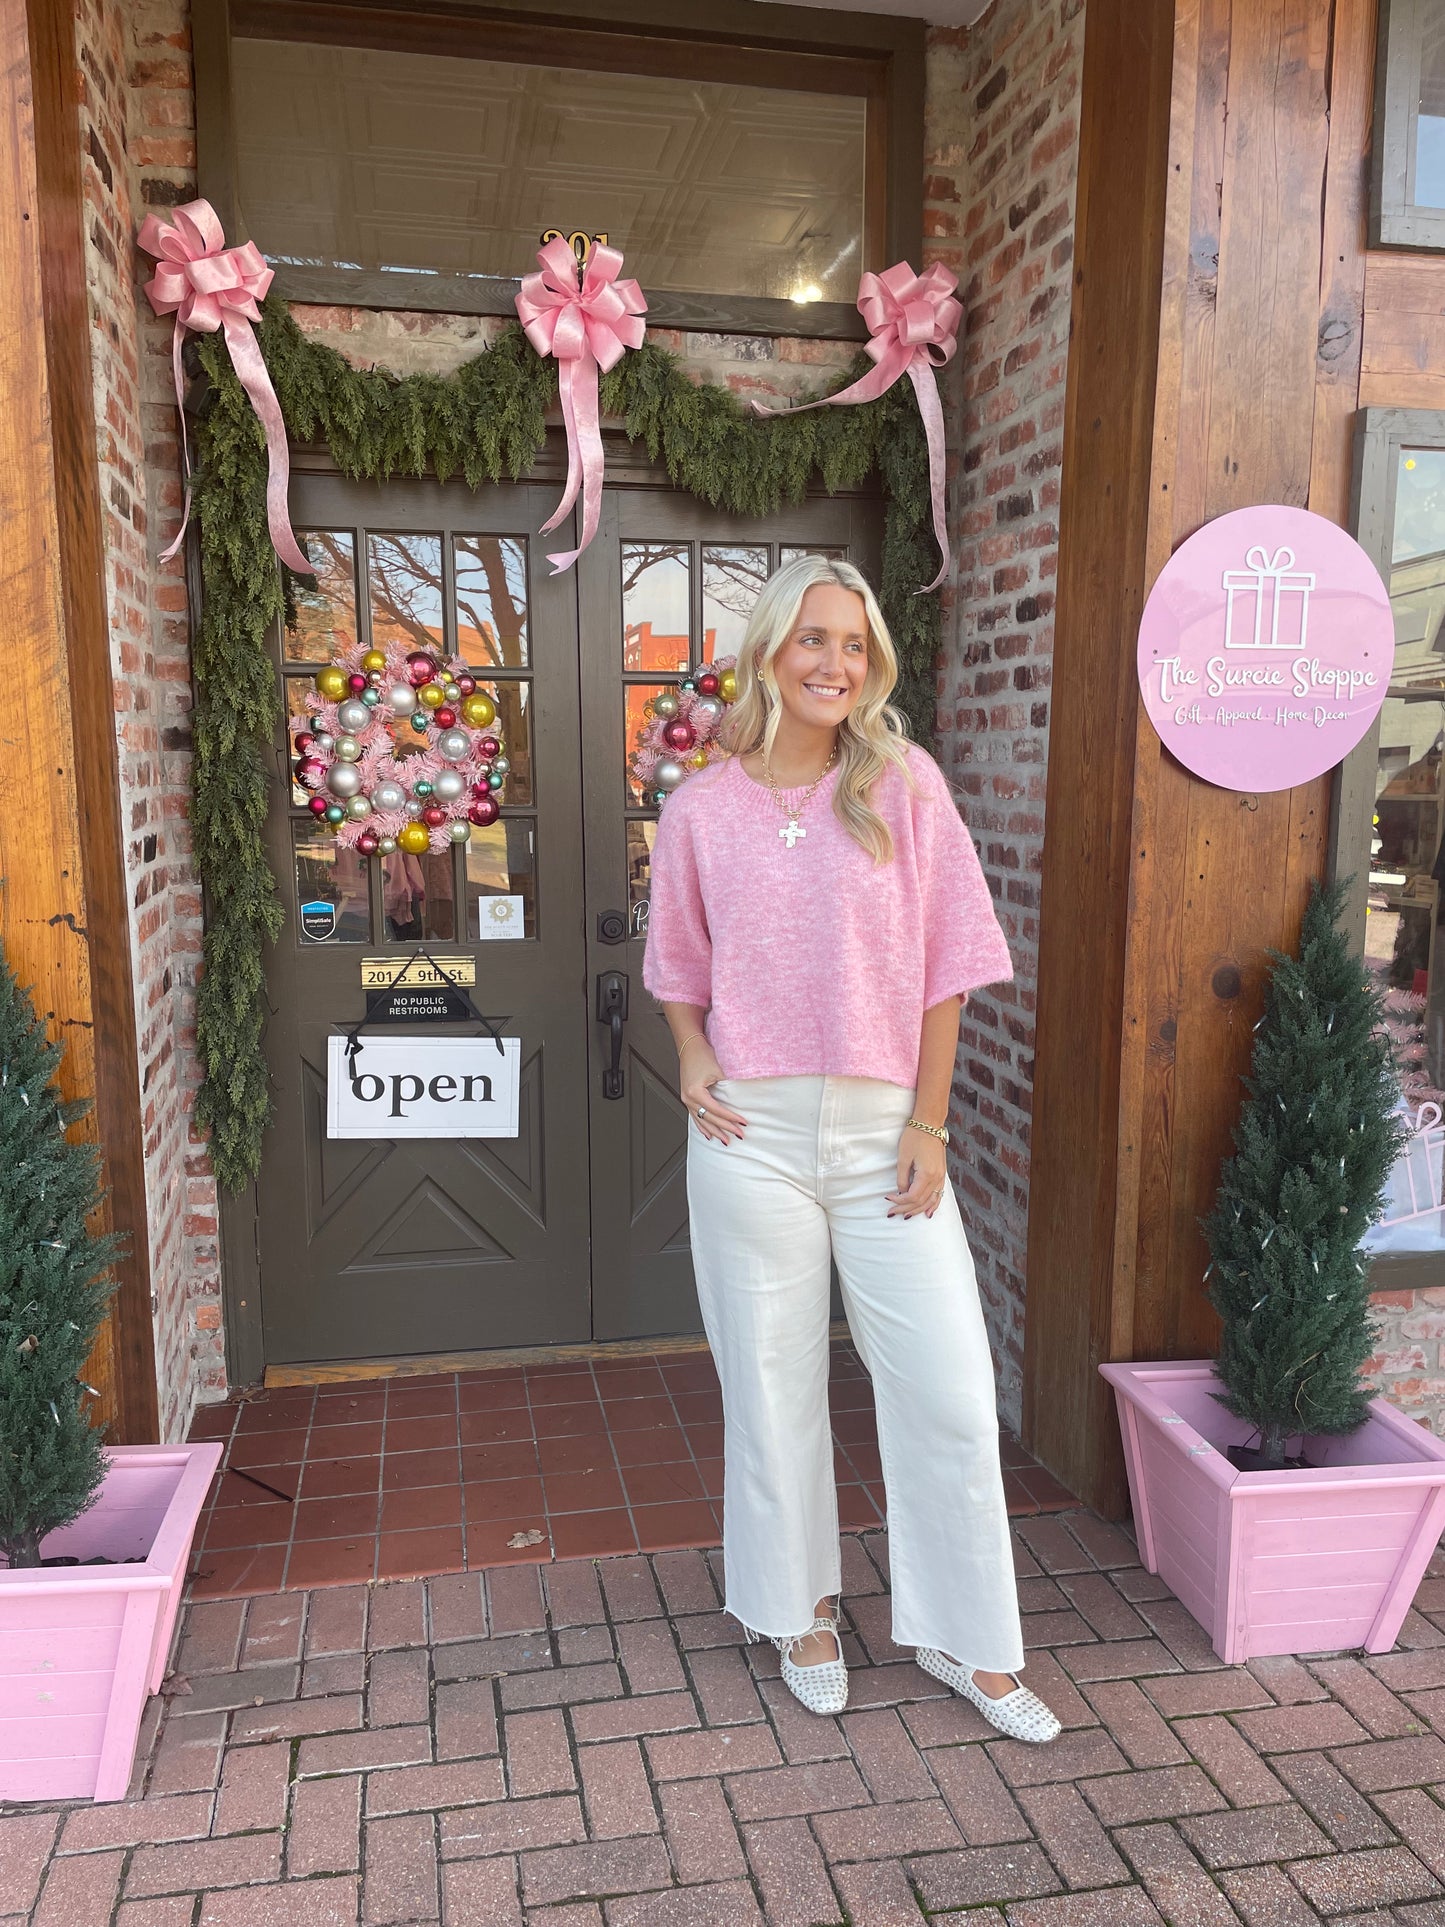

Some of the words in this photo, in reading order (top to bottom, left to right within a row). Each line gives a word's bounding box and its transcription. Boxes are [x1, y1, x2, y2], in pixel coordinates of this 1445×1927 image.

[1153, 656, 1200, 703] The
[1206, 656, 1286, 697] Surcie
[1292, 657, 1378, 700] Shoppe
[1174, 704, 1203, 725] Gift
[1215, 706, 1262, 727] Apparel
[1275, 706, 1308, 727] Home
[1313, 706, 1349, 728] Decor
[368, 971, 392, 983] 201
[418, 969, 443, 982] 9th
[449, 969, 468, 981] St.
[389, 1006, 448, 1015] RESTROOMS
[393, 998, 408, 1006] NO
[410, 997, 444, 1005] PUBLIC
[351, 1073, 496, 1118] open
